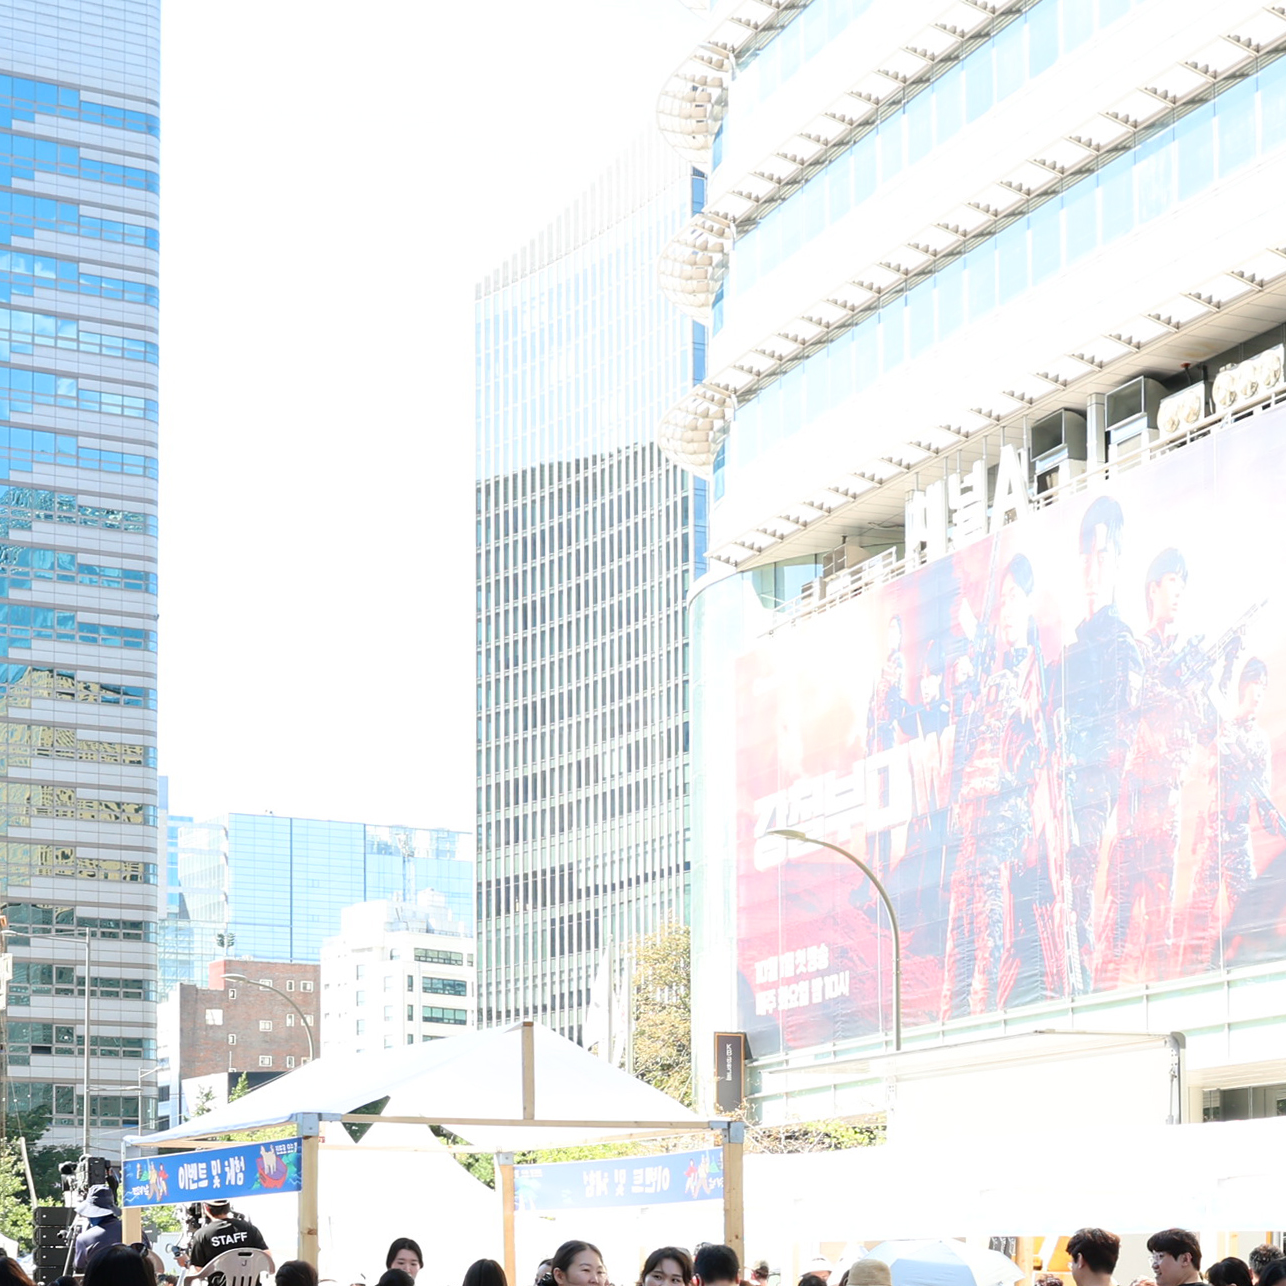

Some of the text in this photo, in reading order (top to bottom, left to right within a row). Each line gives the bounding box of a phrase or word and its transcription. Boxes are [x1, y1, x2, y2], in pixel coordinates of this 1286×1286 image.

[178, 1156, 245, 1190] 이벤트 및 체험
[211, 1231, 248, 1248] STAFF
